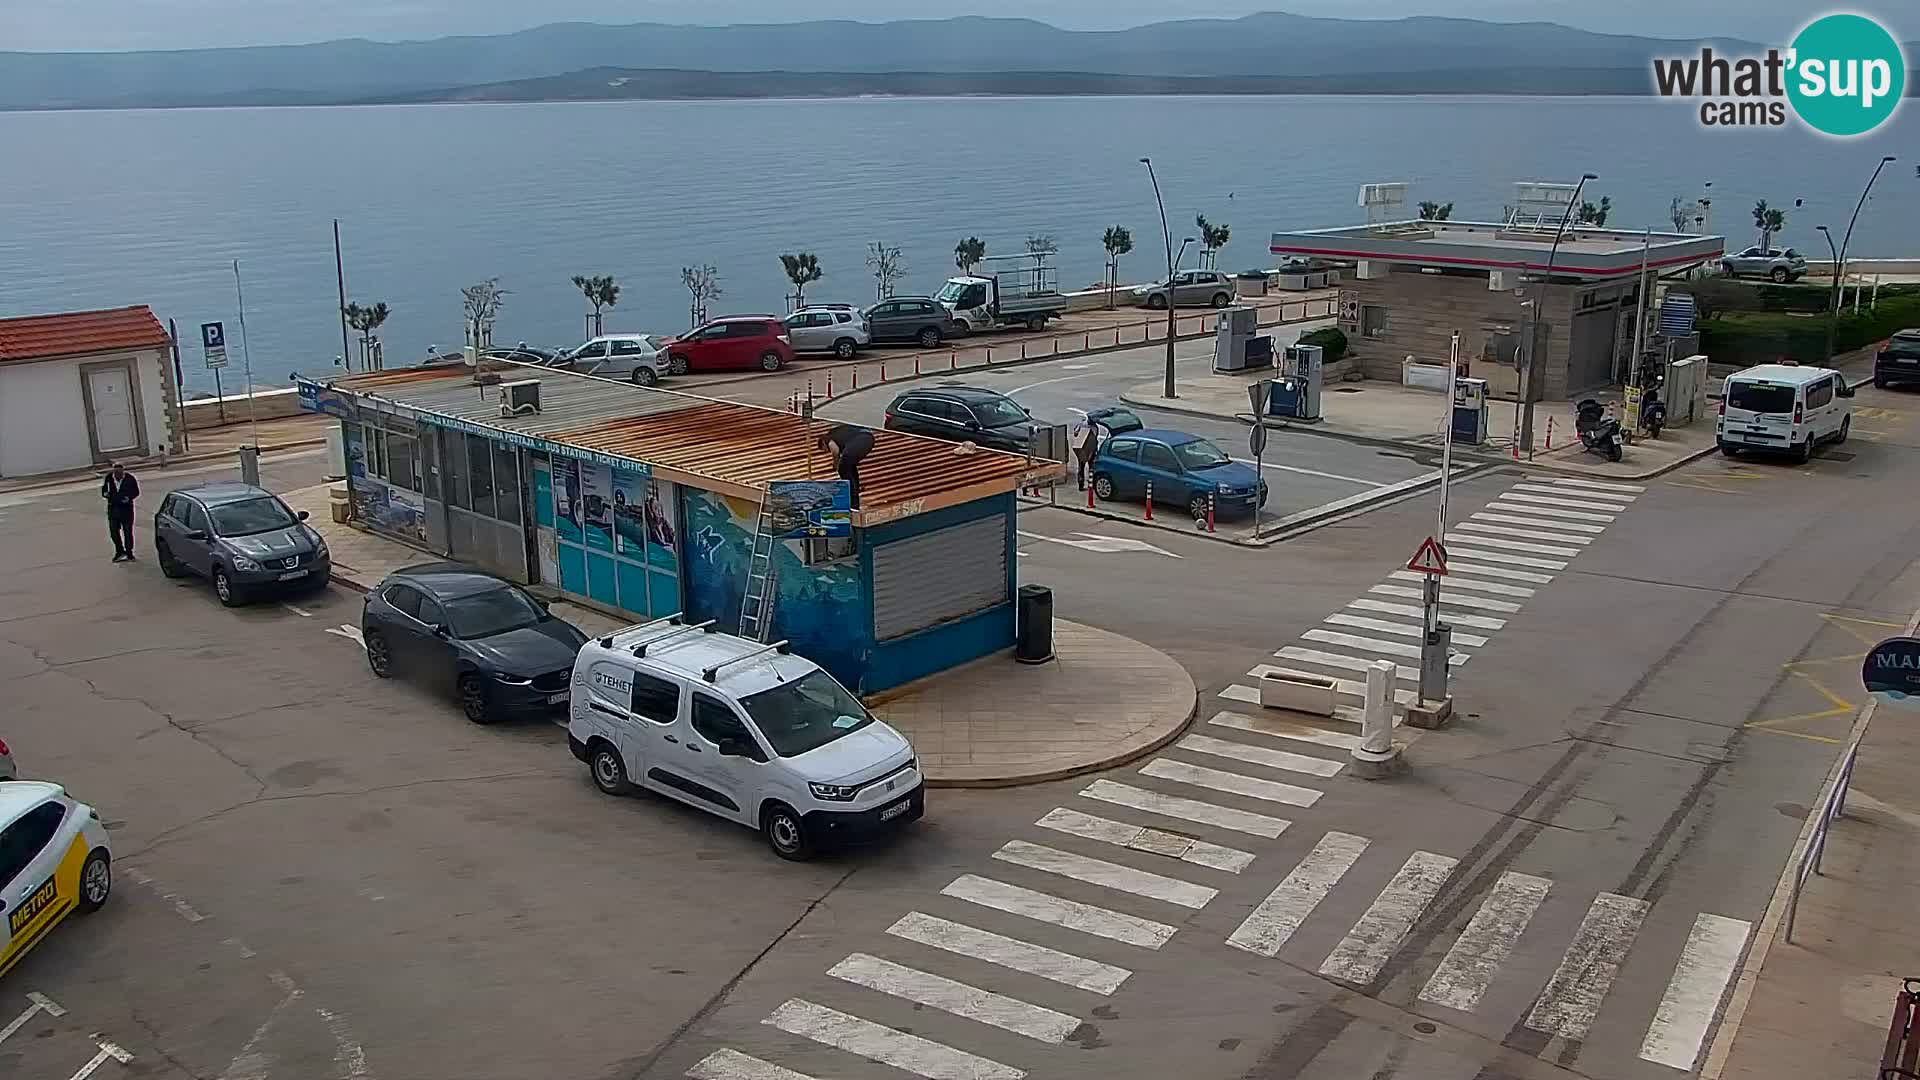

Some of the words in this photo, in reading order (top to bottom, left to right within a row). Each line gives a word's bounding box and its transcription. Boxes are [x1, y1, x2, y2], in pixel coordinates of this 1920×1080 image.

[207, 326, 219, 345] P
[560, 446, 593, 461] STATION
[595, 453, 621, 468] TICKET
[621, 460, 649, 474] OFFICE
[12, 882, 54, 917] METRO
